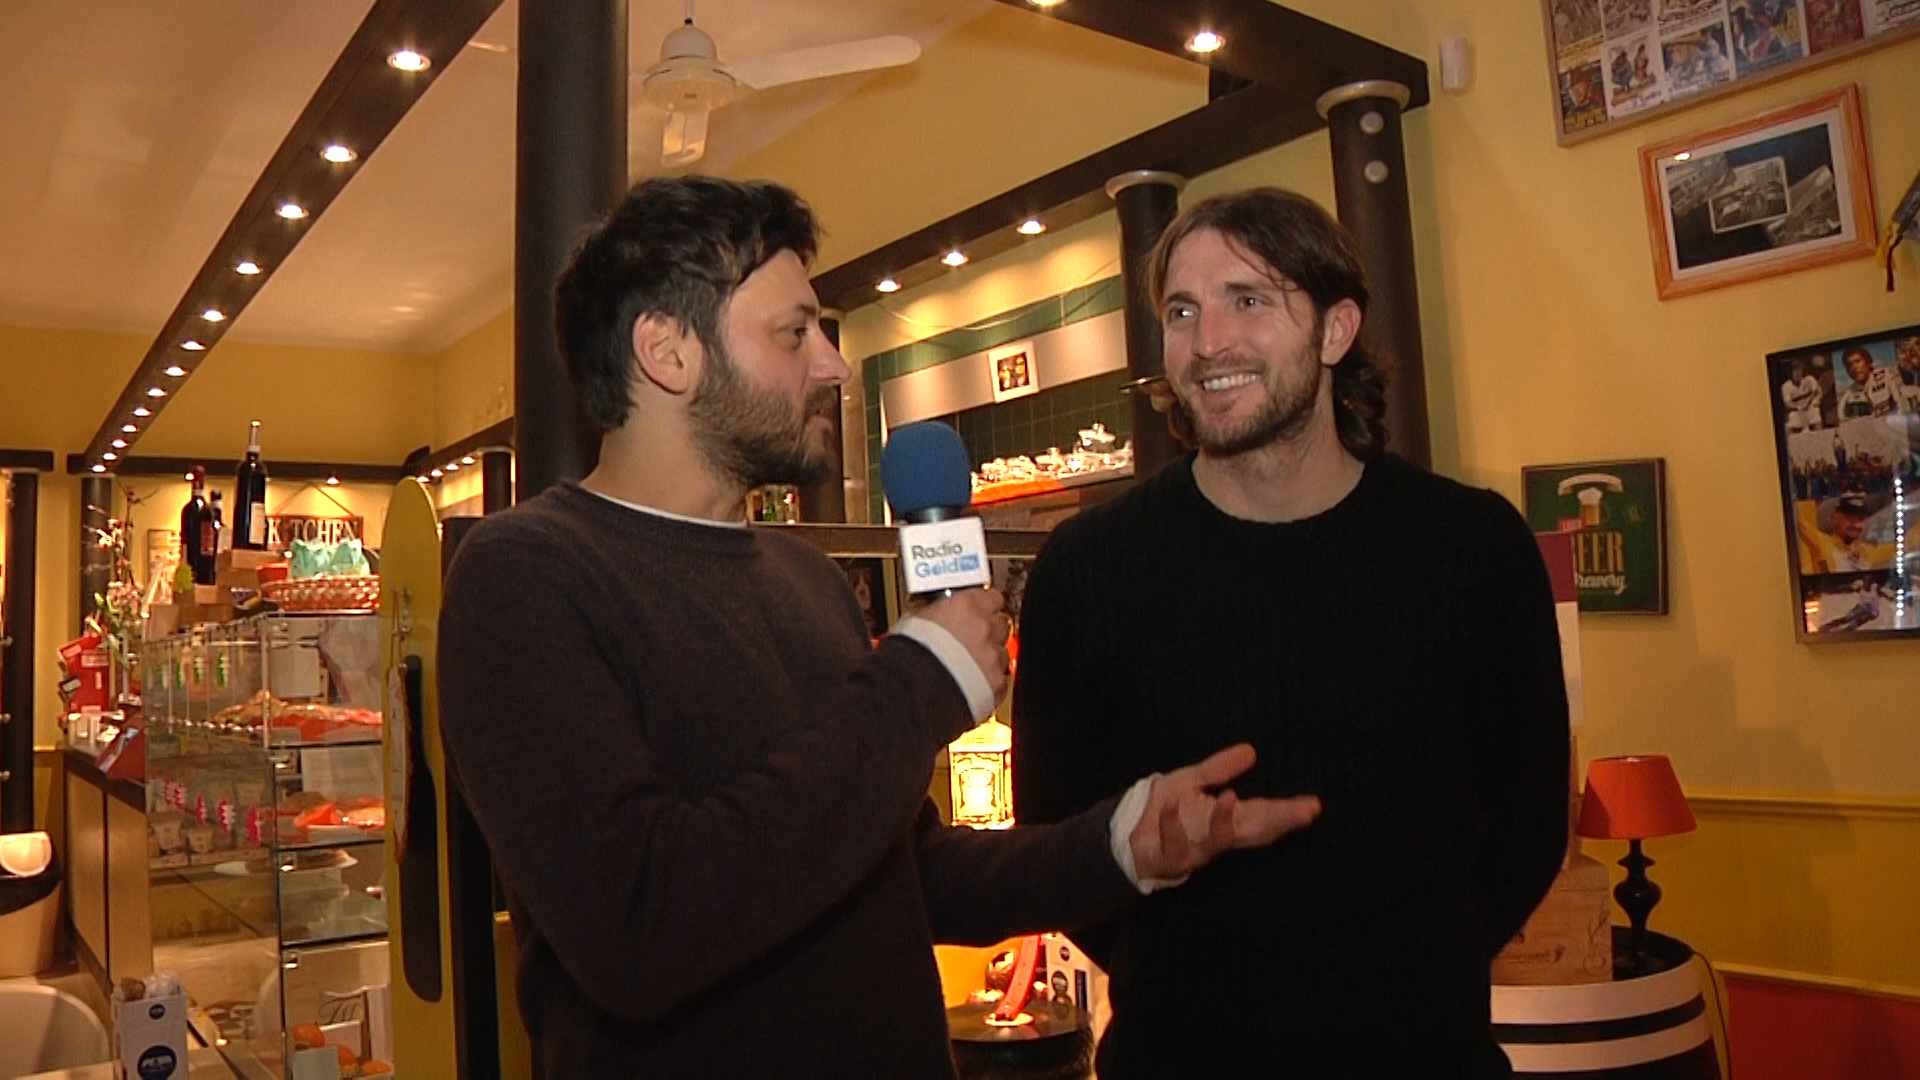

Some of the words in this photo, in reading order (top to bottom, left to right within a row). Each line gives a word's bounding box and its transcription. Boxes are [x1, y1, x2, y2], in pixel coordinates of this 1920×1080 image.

[267, 517, 358, 546] KTCHEN
[911, 540, 963, 560] Radio
[1577, 531, 1624, 573] EER
[914, 558, 959, 578] Gold
[1576, 573, 1628, 597] rewery
